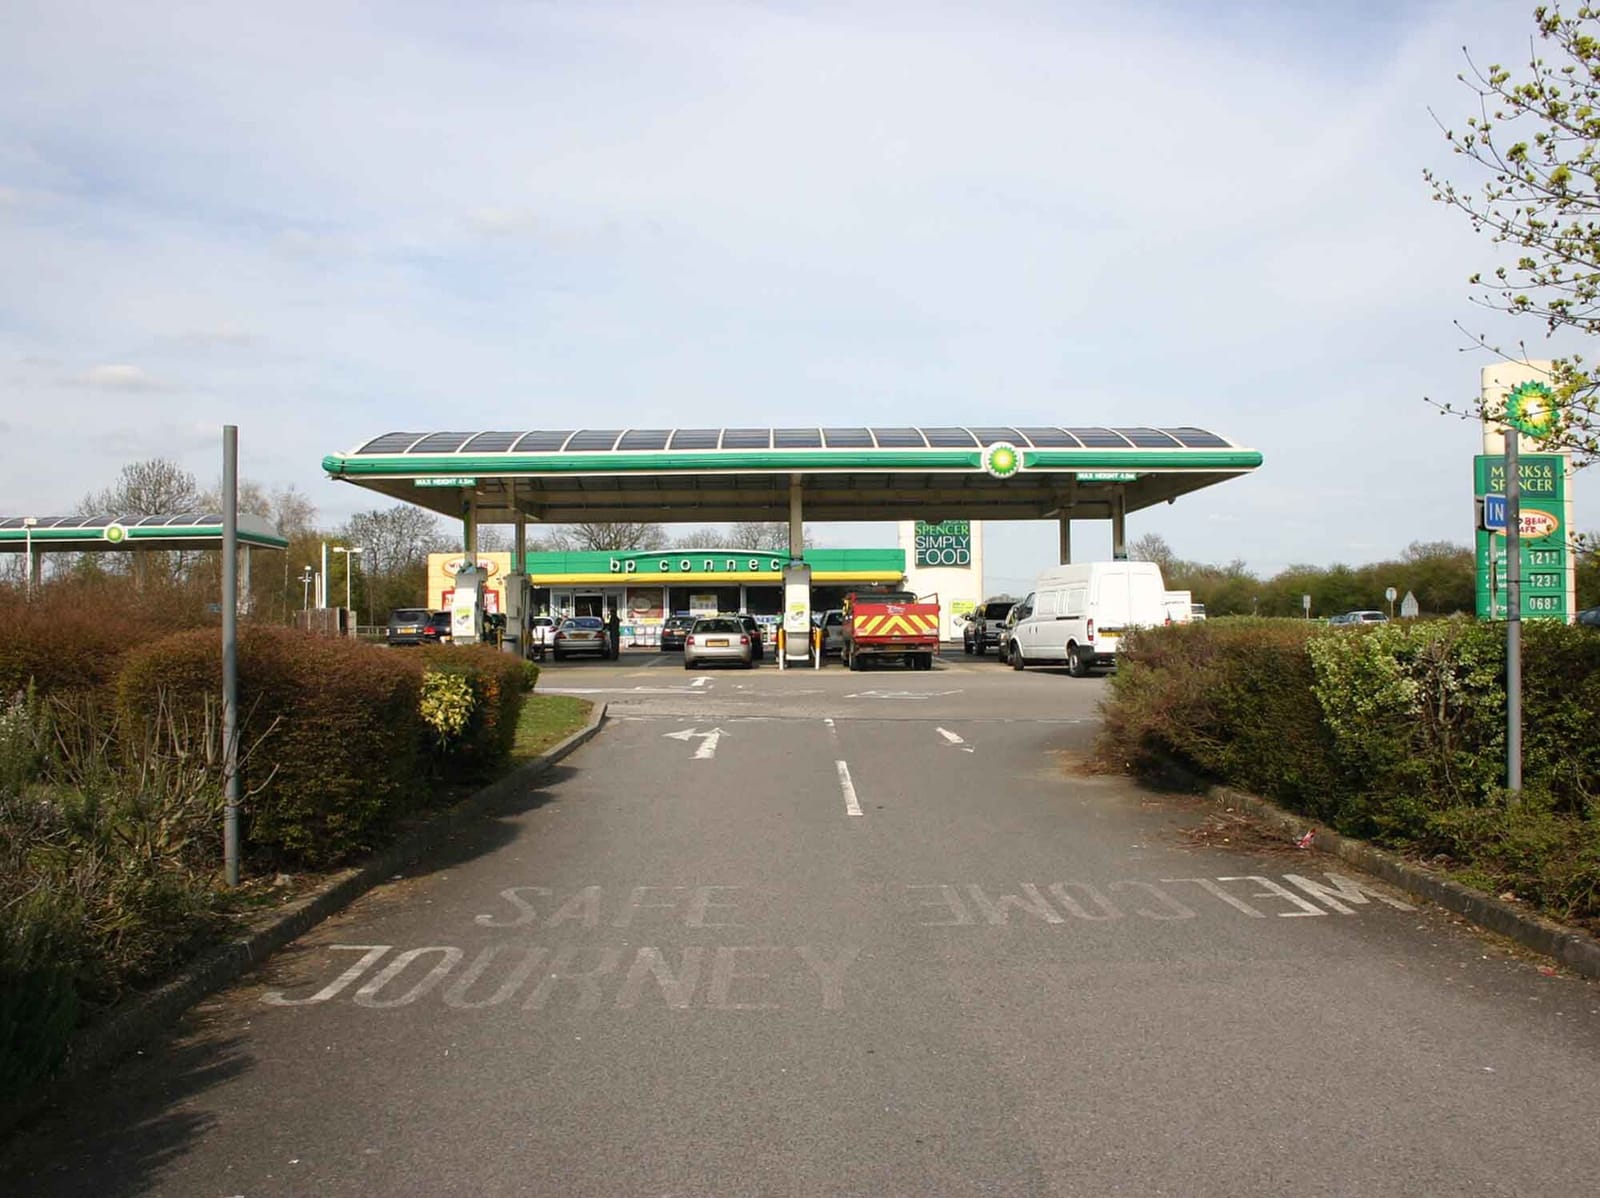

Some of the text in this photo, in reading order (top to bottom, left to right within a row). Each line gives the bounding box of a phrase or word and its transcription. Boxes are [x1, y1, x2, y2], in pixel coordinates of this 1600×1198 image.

[1490, 465, 1552, 478] MRKS &
[1490, 479, 1553, 491] SPNCER
[1489, 502, 1504, 521] IN
[915, 525, 969, 535] SPENCER
[915, 535, 970, 549] SIMPLY
[915, 548, 970, 565] FOOD
[610, 557, 780, 574] bp connec
[474, 885, 745, 928] SAFE
[906, 871, 1415, 926] WELCOME
[261, 944, 861, 1011] JOURNEY
